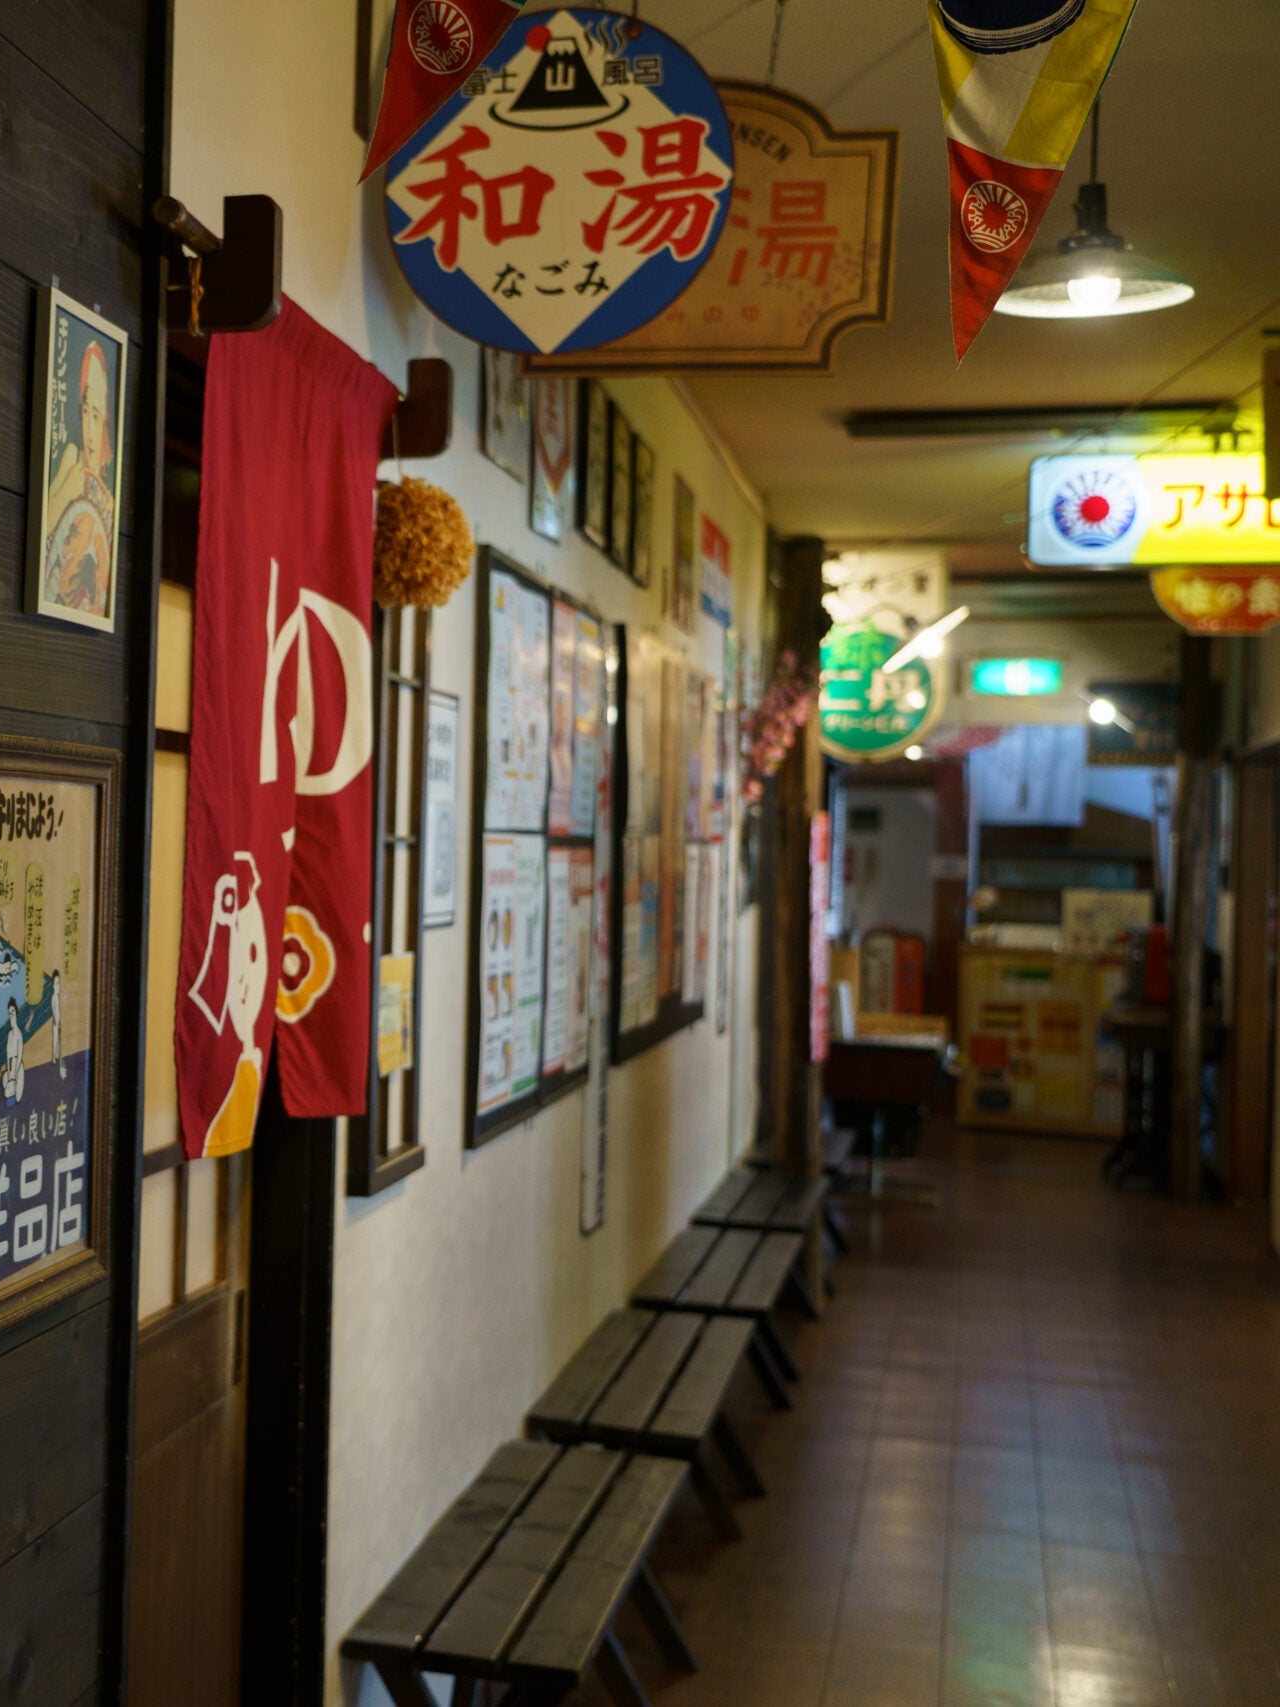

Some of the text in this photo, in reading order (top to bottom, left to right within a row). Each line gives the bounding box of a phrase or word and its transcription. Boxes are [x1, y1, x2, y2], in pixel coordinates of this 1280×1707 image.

[394, 113, 727, 273] 和湯
[493, 260, 610, 298] なごみ
[259, 556, 375, 797] ゆ
